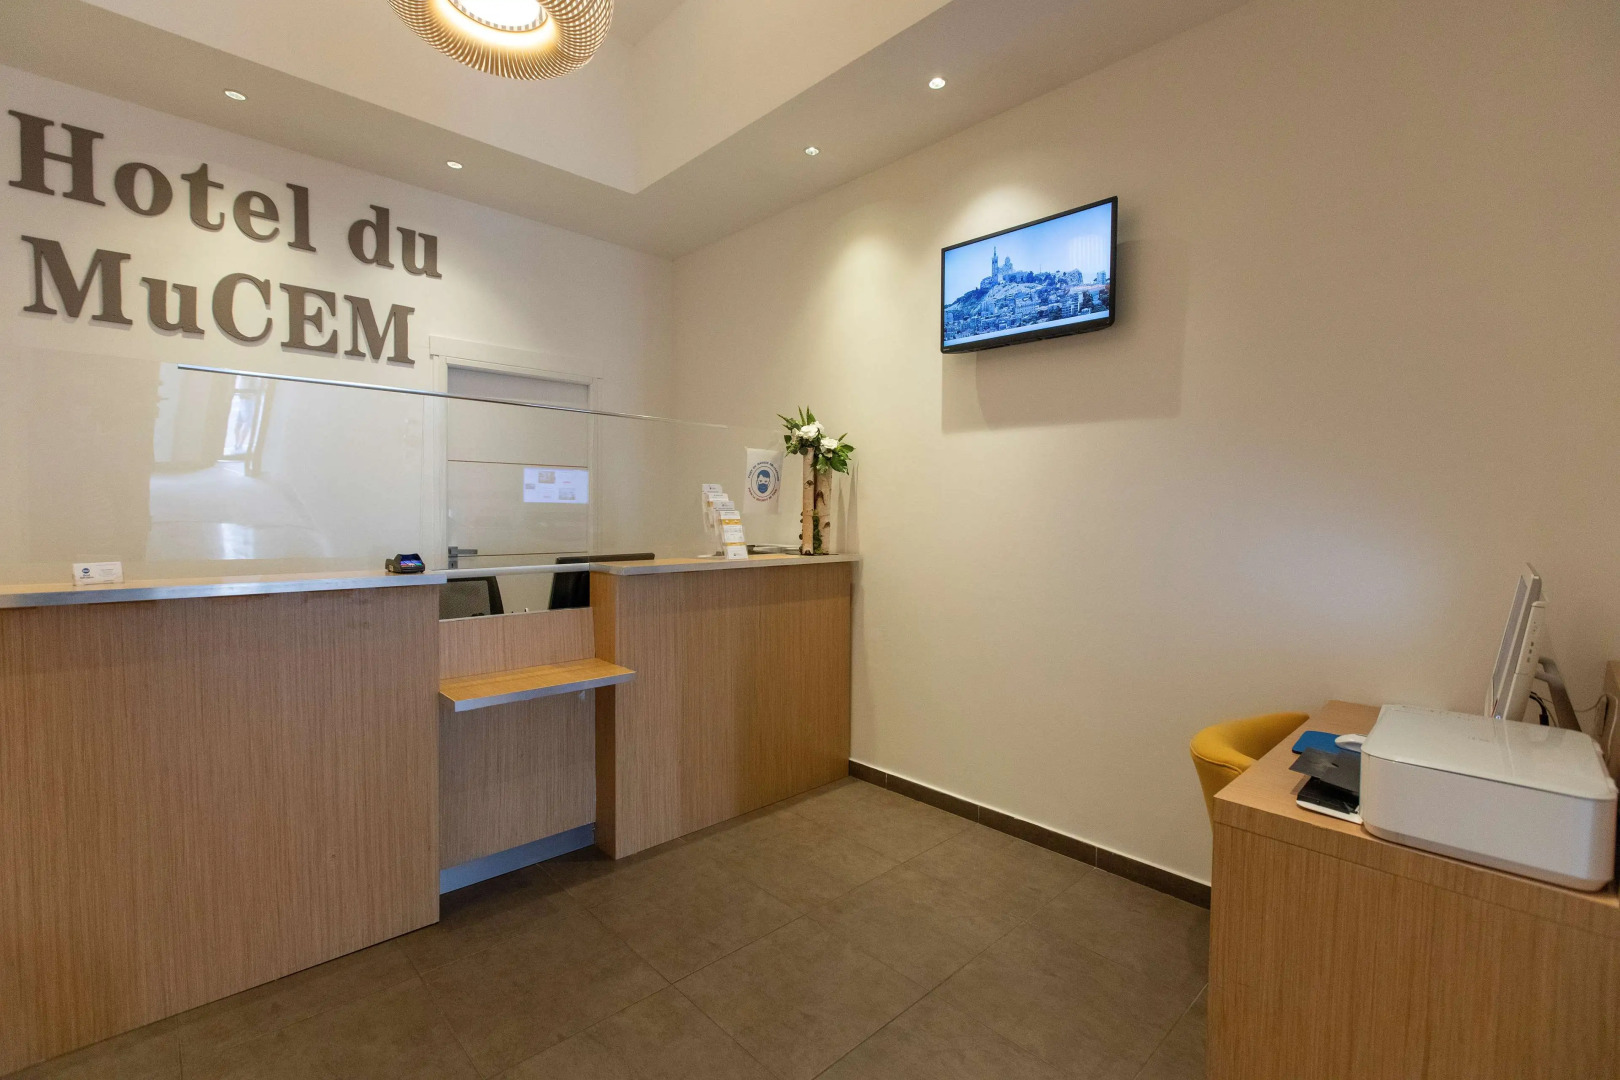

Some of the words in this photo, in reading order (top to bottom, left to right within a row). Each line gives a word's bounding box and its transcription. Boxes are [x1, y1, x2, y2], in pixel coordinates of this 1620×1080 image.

[8, 109, 316, 253] Hotel
[347, 204, 442, 278] du
[21, 234, 416, 365] MuCEM
